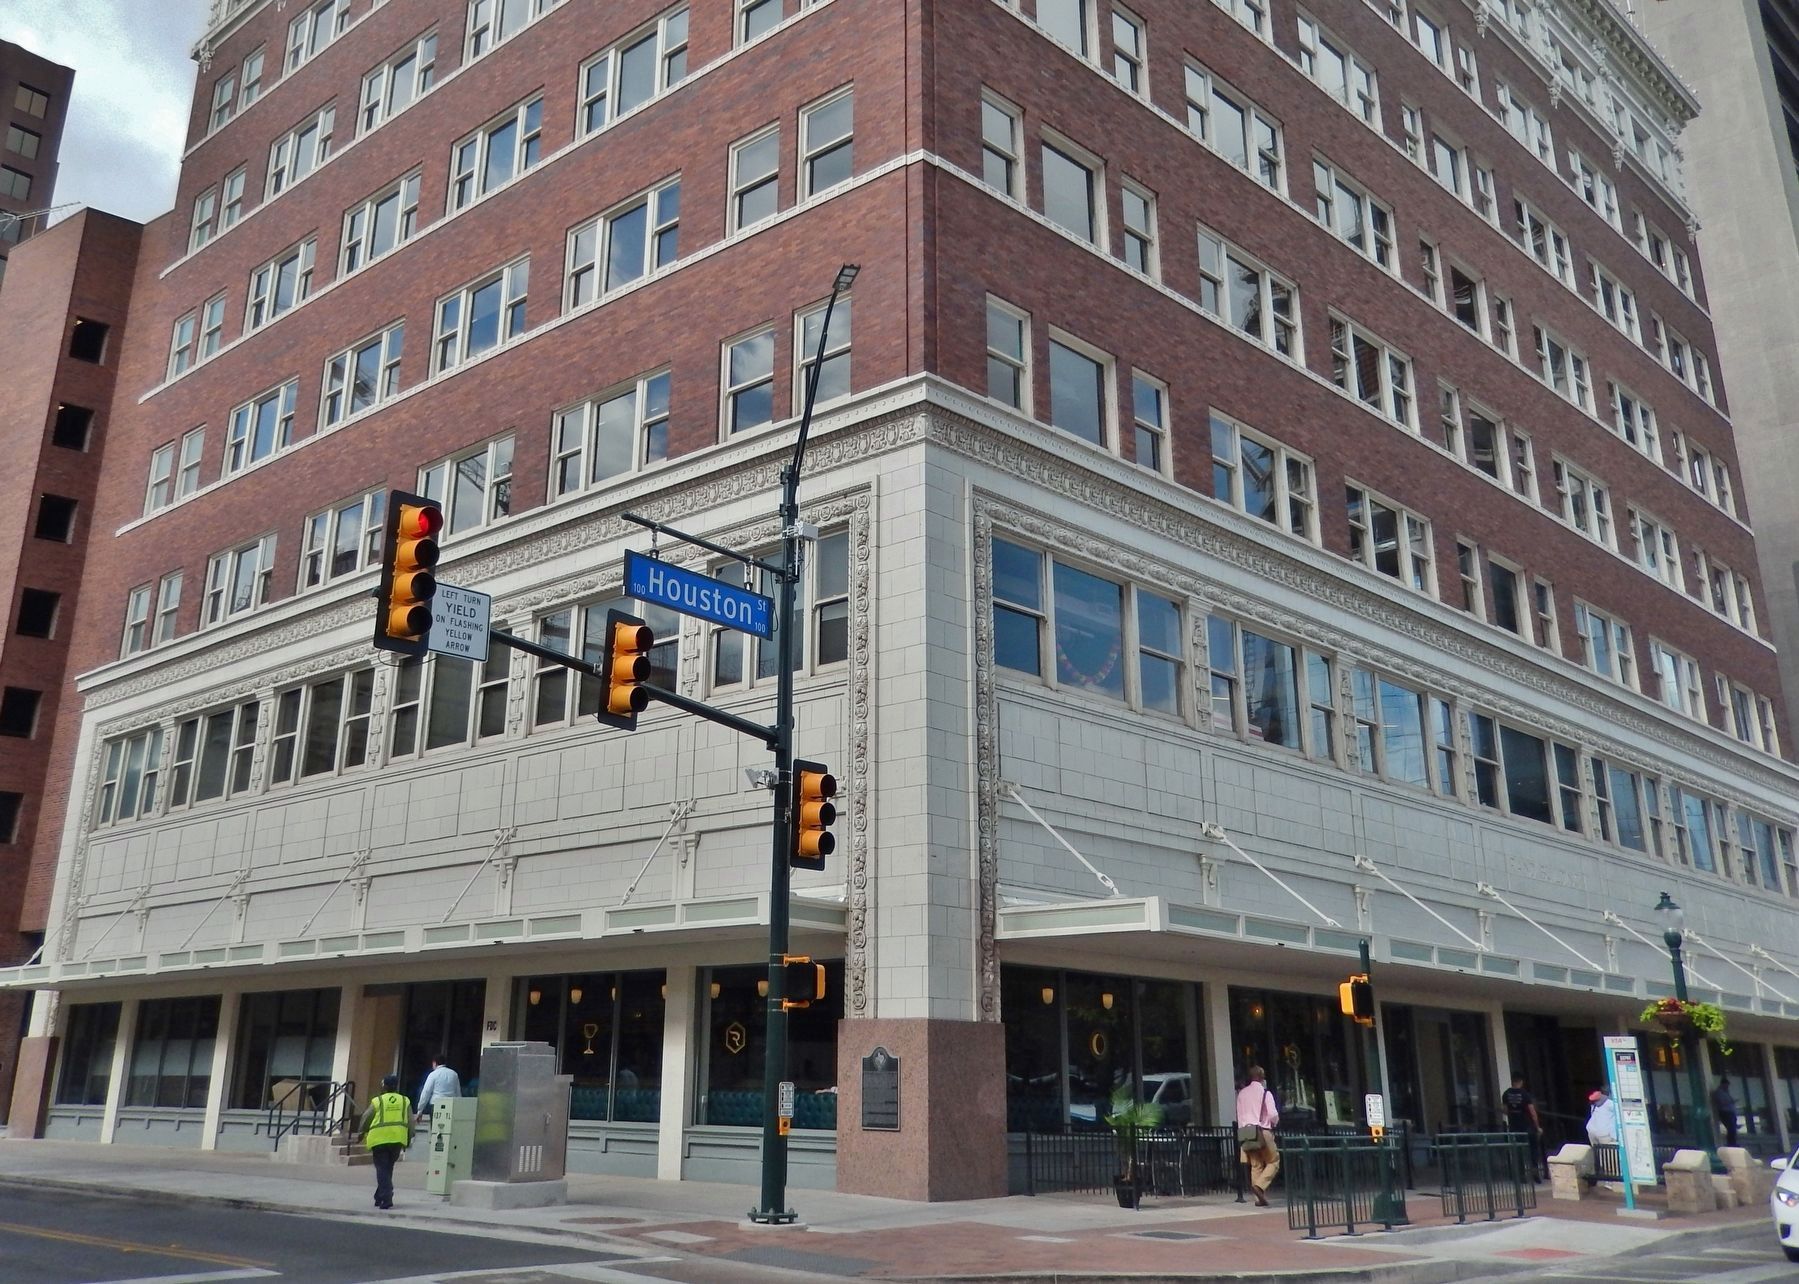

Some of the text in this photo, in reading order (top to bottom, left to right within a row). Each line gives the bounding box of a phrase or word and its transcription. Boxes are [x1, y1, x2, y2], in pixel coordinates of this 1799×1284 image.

[441, 589, 482, 606] LEFT TURN
[633, 567, 767, 625] 100 Houston St
[446, 602, 477, 618] YIELD
[435, 614, 483, 632] ON FLASHING
[755, 622, 766, 633] 100
[445, 628, 473, 641] YELLOW
[445, 640, 471, 653] ARROW
